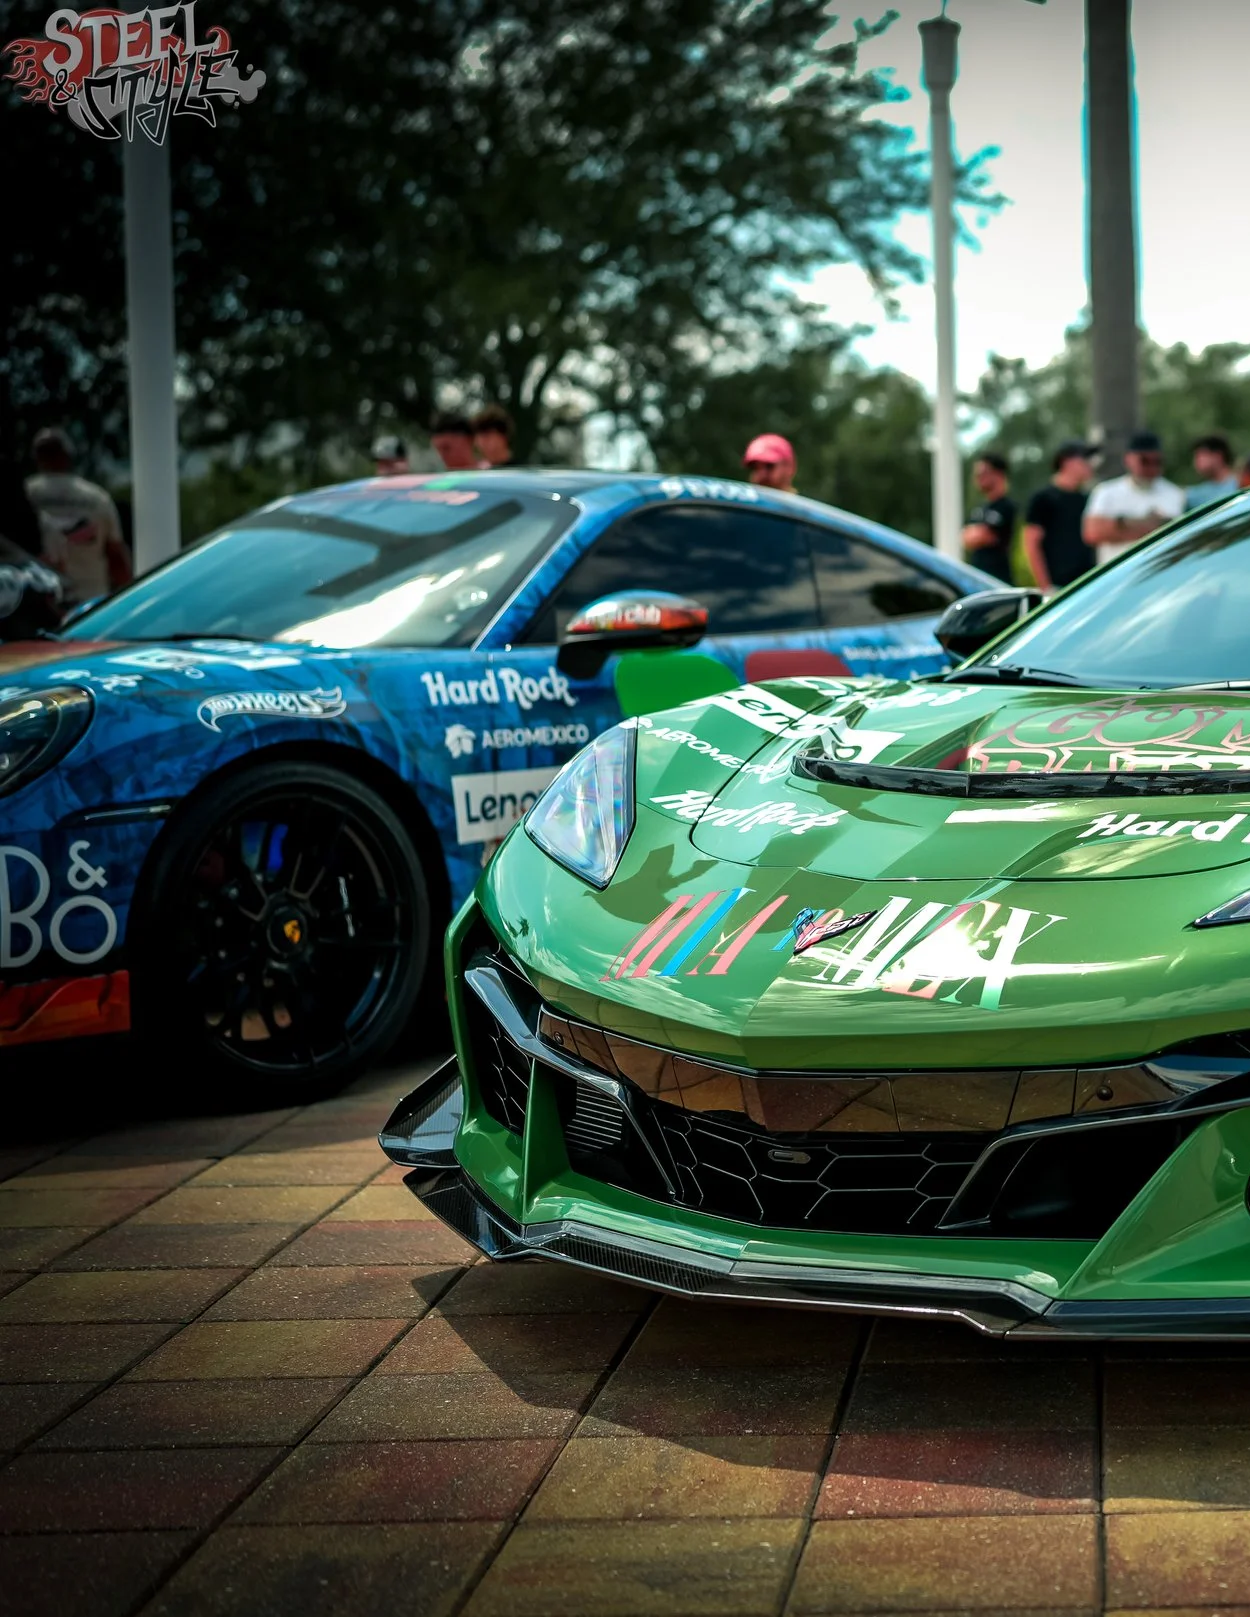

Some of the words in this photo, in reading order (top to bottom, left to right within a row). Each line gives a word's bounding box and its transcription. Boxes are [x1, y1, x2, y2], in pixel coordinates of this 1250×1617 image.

[421, 669, 500, 706] Hard
[499, 666, 577, 709] Rock
[482, 724, 589, 749] AEROMEXICO
[1076, 813, 1248, 842] Hard
